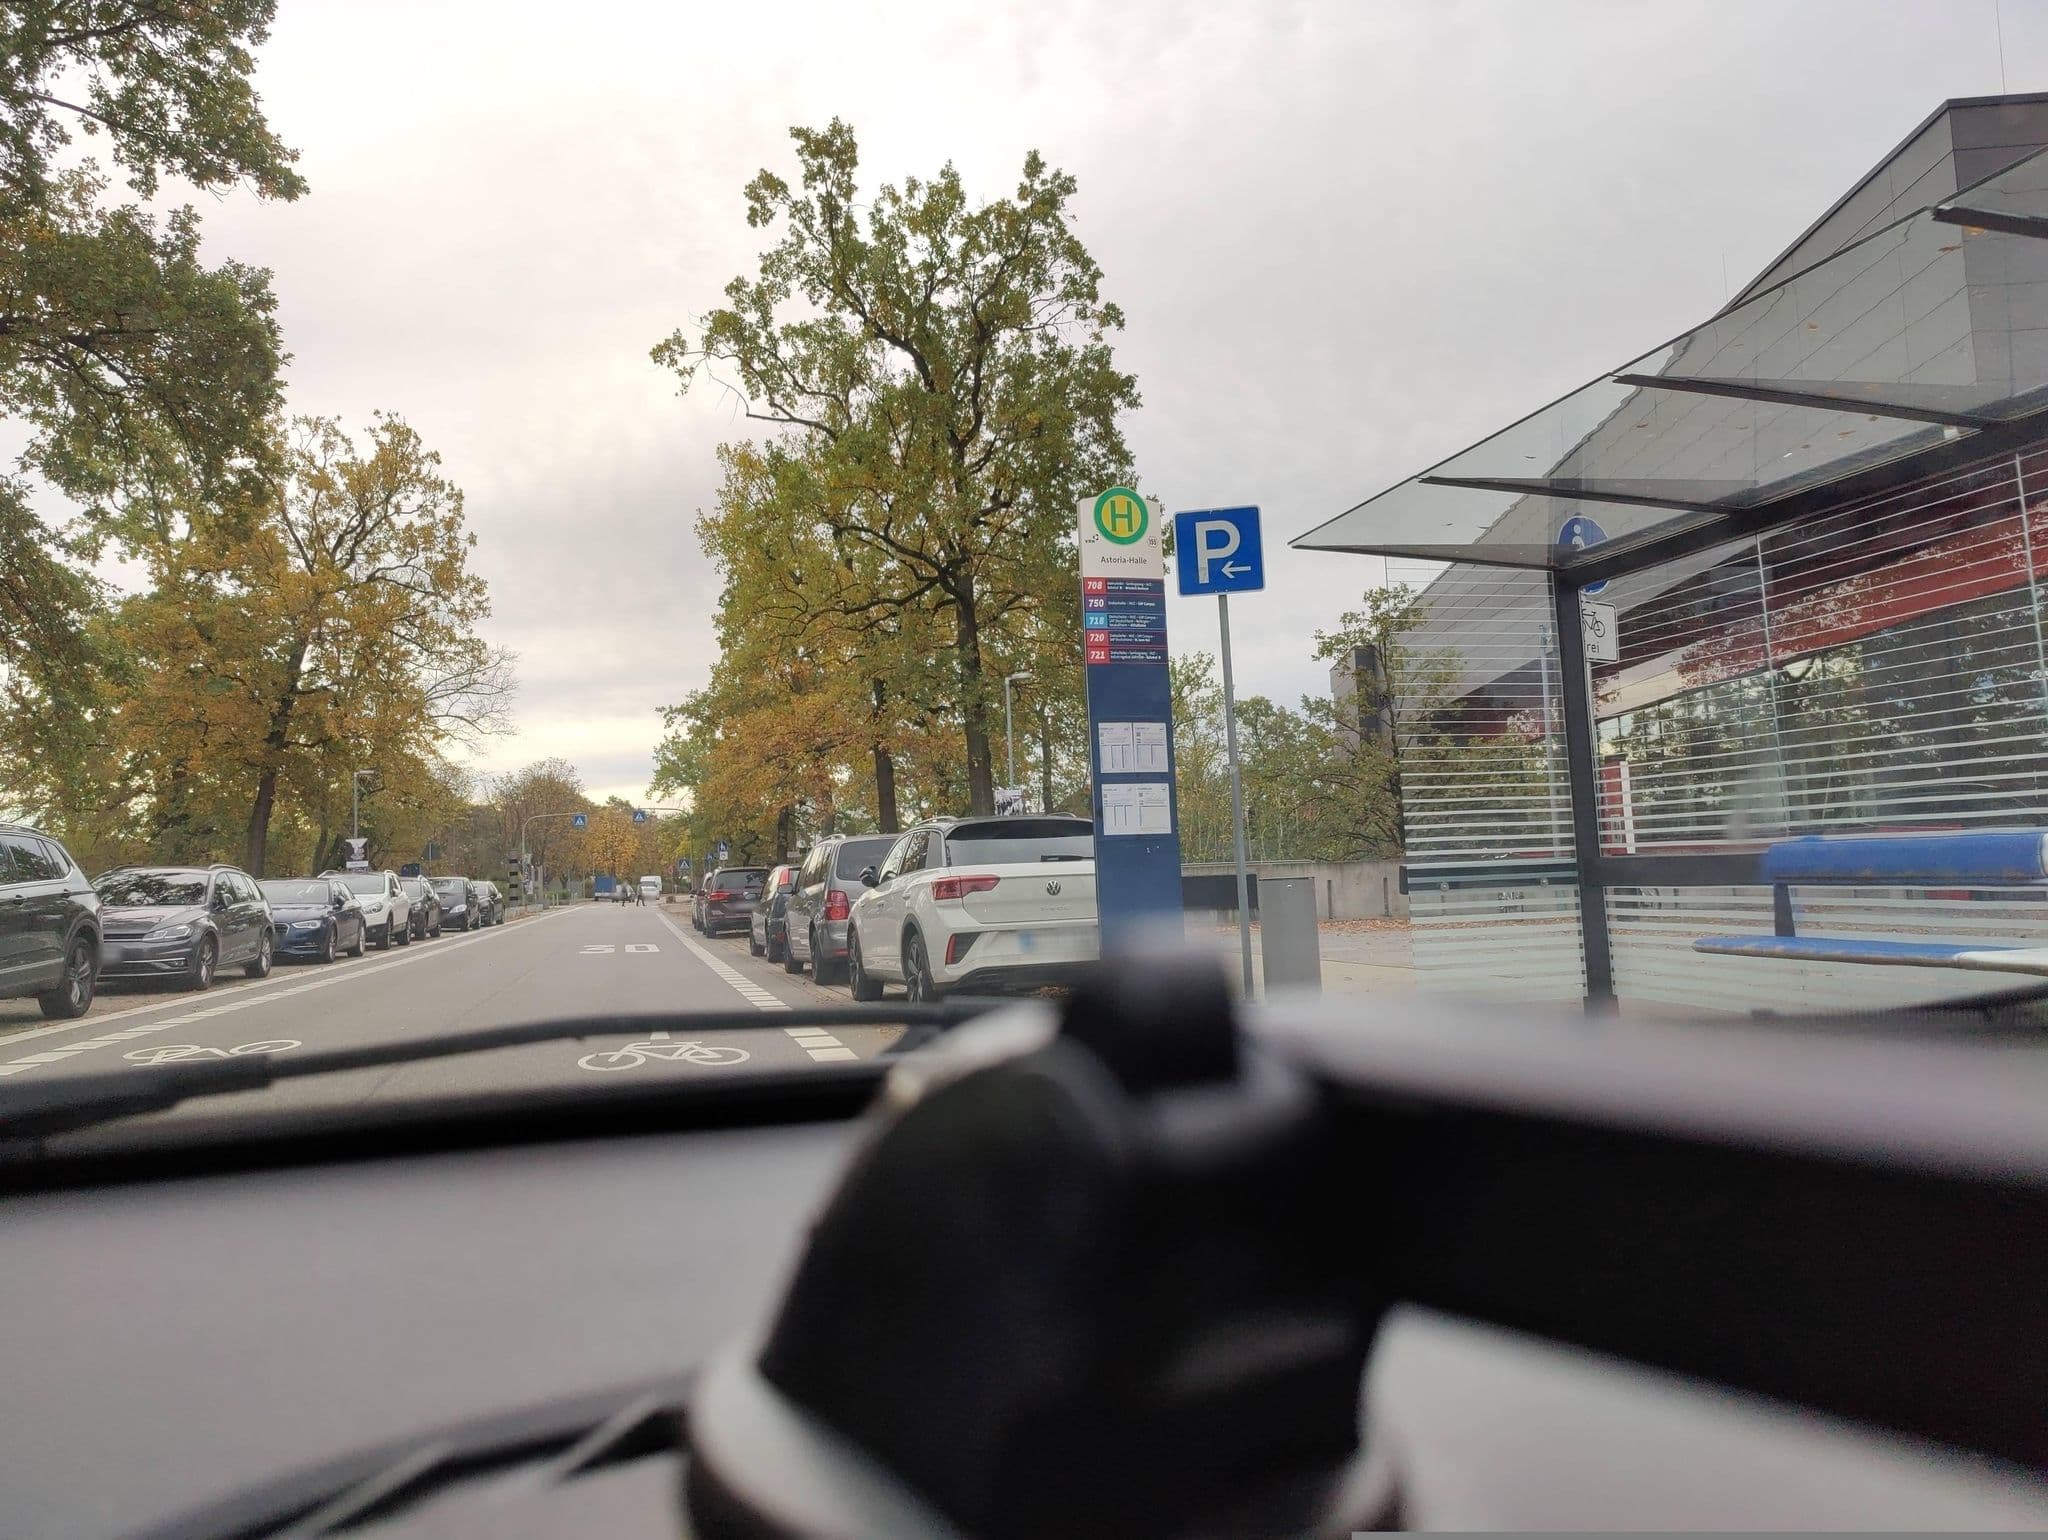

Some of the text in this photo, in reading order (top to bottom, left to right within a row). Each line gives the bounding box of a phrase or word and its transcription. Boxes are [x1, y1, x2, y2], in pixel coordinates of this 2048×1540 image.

[1110, 500, 1134, 533] H
[1195, 520, 1241, 584] P
[1100, 555, 1148, 565] Astoria-Halle
[1087, 581, 1103, 590] 708
[1088, 599, 1104, 608] 750
[1089, 616, 1105, 625] 718
[1089, 633, 1105, 642] 720
[1090, 650, 1106, 660] 721
[579, 944, 660, 954] 30
